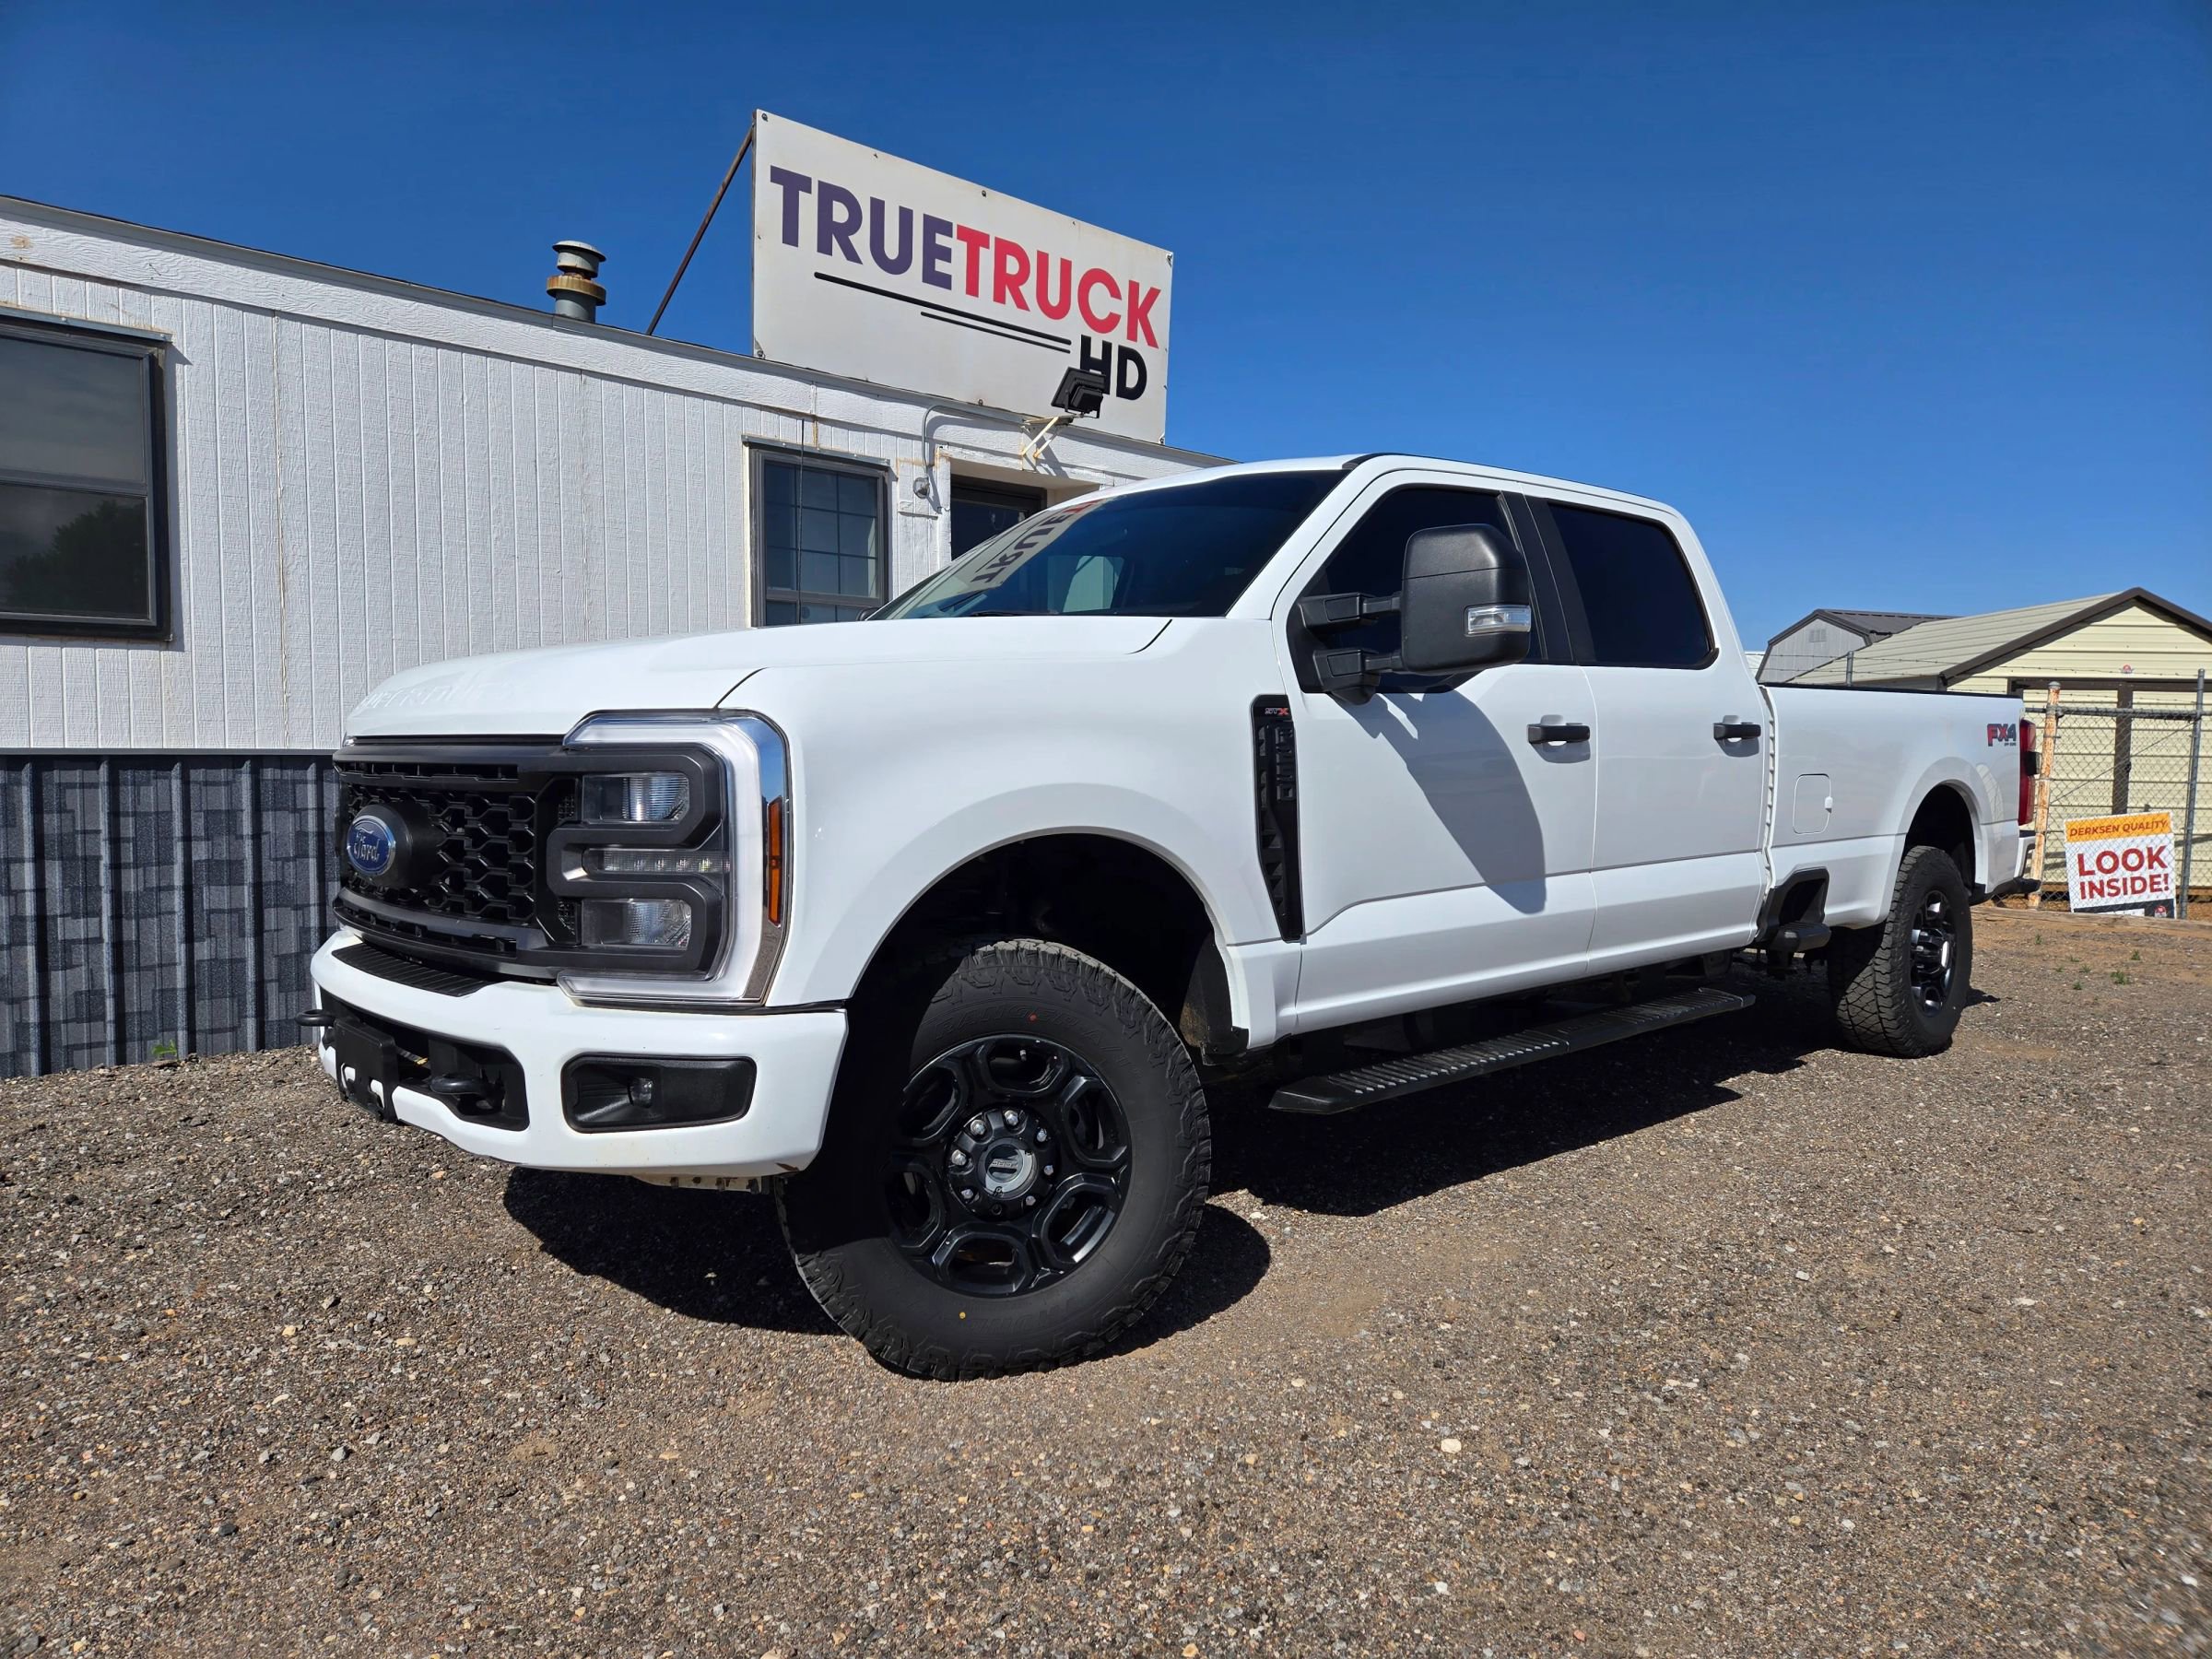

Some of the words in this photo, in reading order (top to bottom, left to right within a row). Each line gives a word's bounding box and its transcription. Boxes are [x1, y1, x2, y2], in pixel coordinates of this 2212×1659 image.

[1080, 334, 1147, 400] HD
[1987, 724, 2017, 747] FX4
[2069, 825, 2120, 837] DERKSEN
[2122, 820, 2168, 833] QUALITY
[353, 827, 380, 862] Ford
[2077, 845, 2169, 877] LOOK
[2079, 874, 2170, 900] INSIDE!
